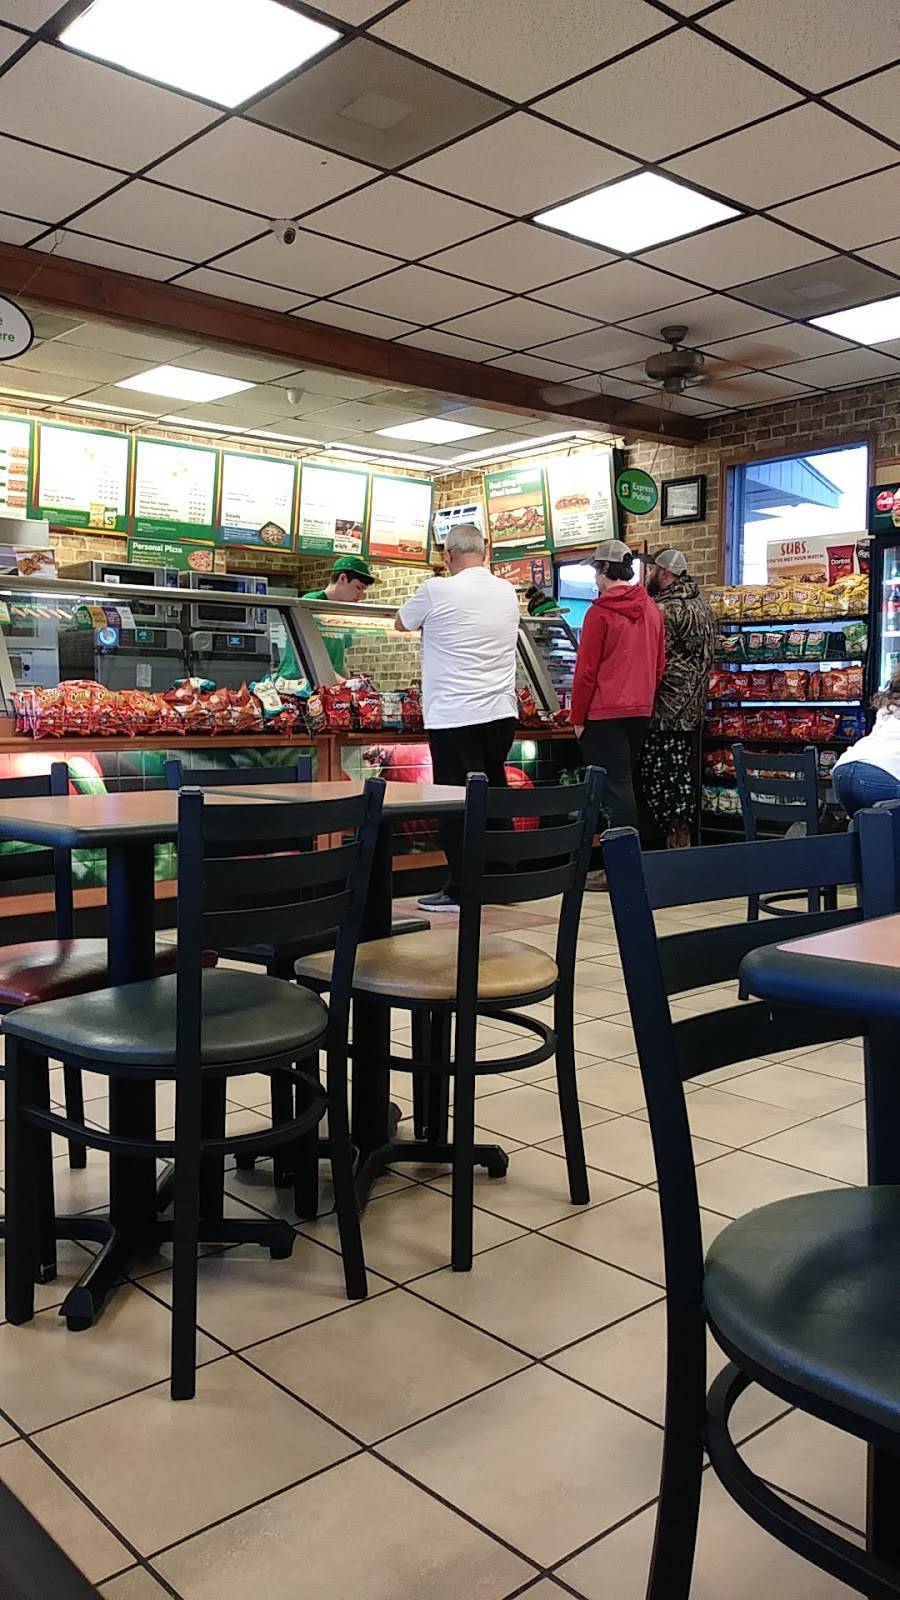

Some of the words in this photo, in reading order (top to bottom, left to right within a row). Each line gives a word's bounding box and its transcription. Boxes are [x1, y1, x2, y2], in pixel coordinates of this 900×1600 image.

[632, 482, 654, 493] Express
[632, 491, 651, 503] Pickup
[132, 541, 163, 552] Personal
[164, 544, 183, 554] Pizza
[780, 540, 810, 556] SUBS.
